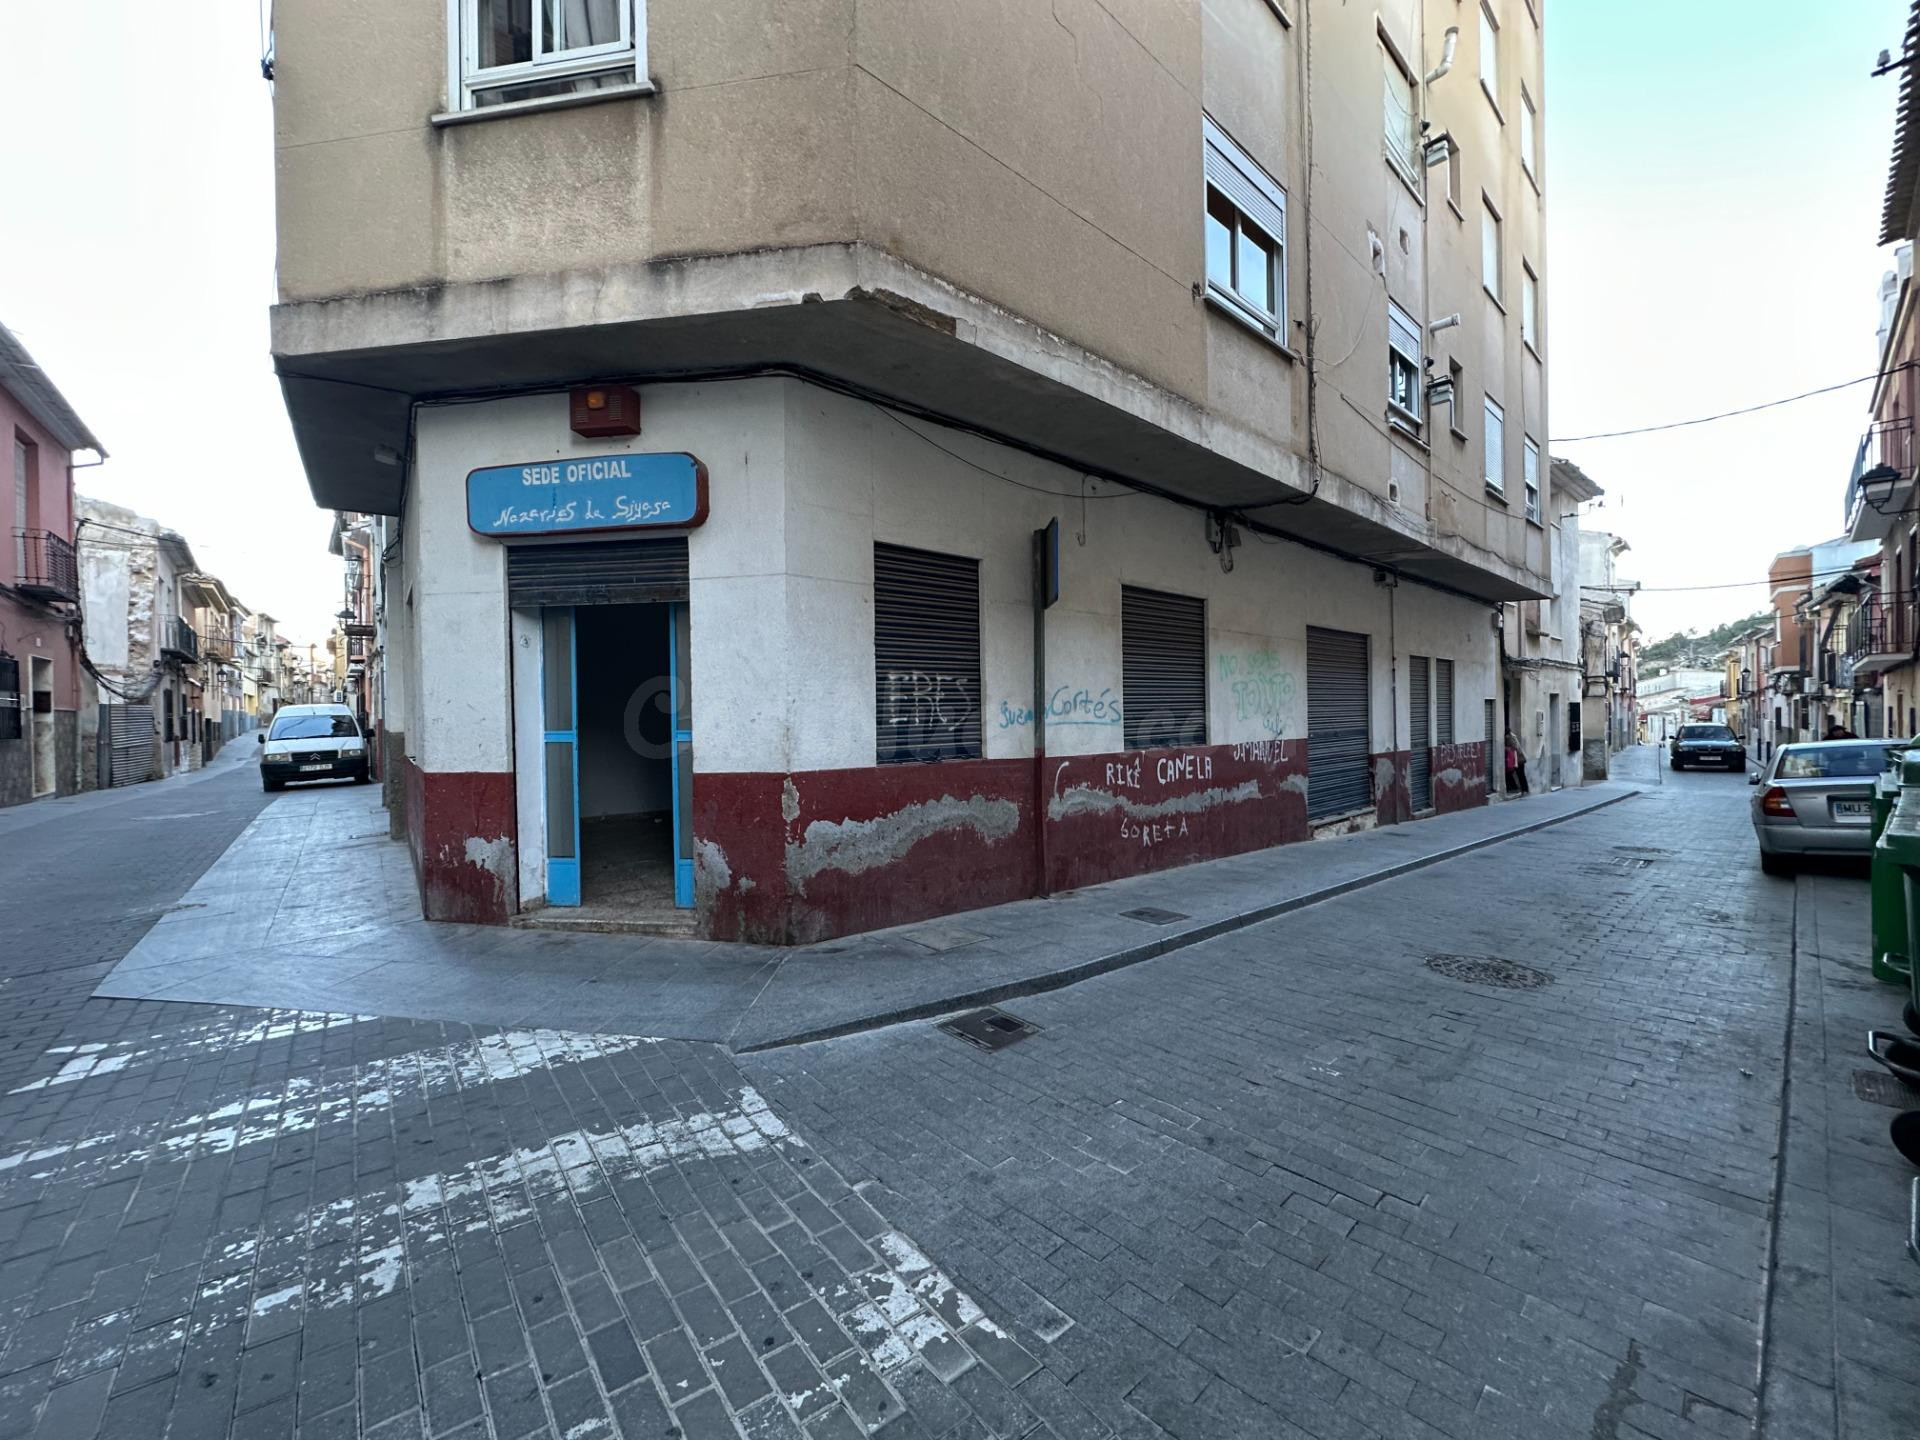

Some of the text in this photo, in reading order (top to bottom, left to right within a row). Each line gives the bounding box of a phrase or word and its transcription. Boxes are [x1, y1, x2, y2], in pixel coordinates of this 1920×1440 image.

[522, 460, 632, 486] SEDE OFICIAL
[612, 495, 672, 522] Siyasa
[888, 671, 971, 731] ERES
[1157, 753, 1212, 784] CANELA
